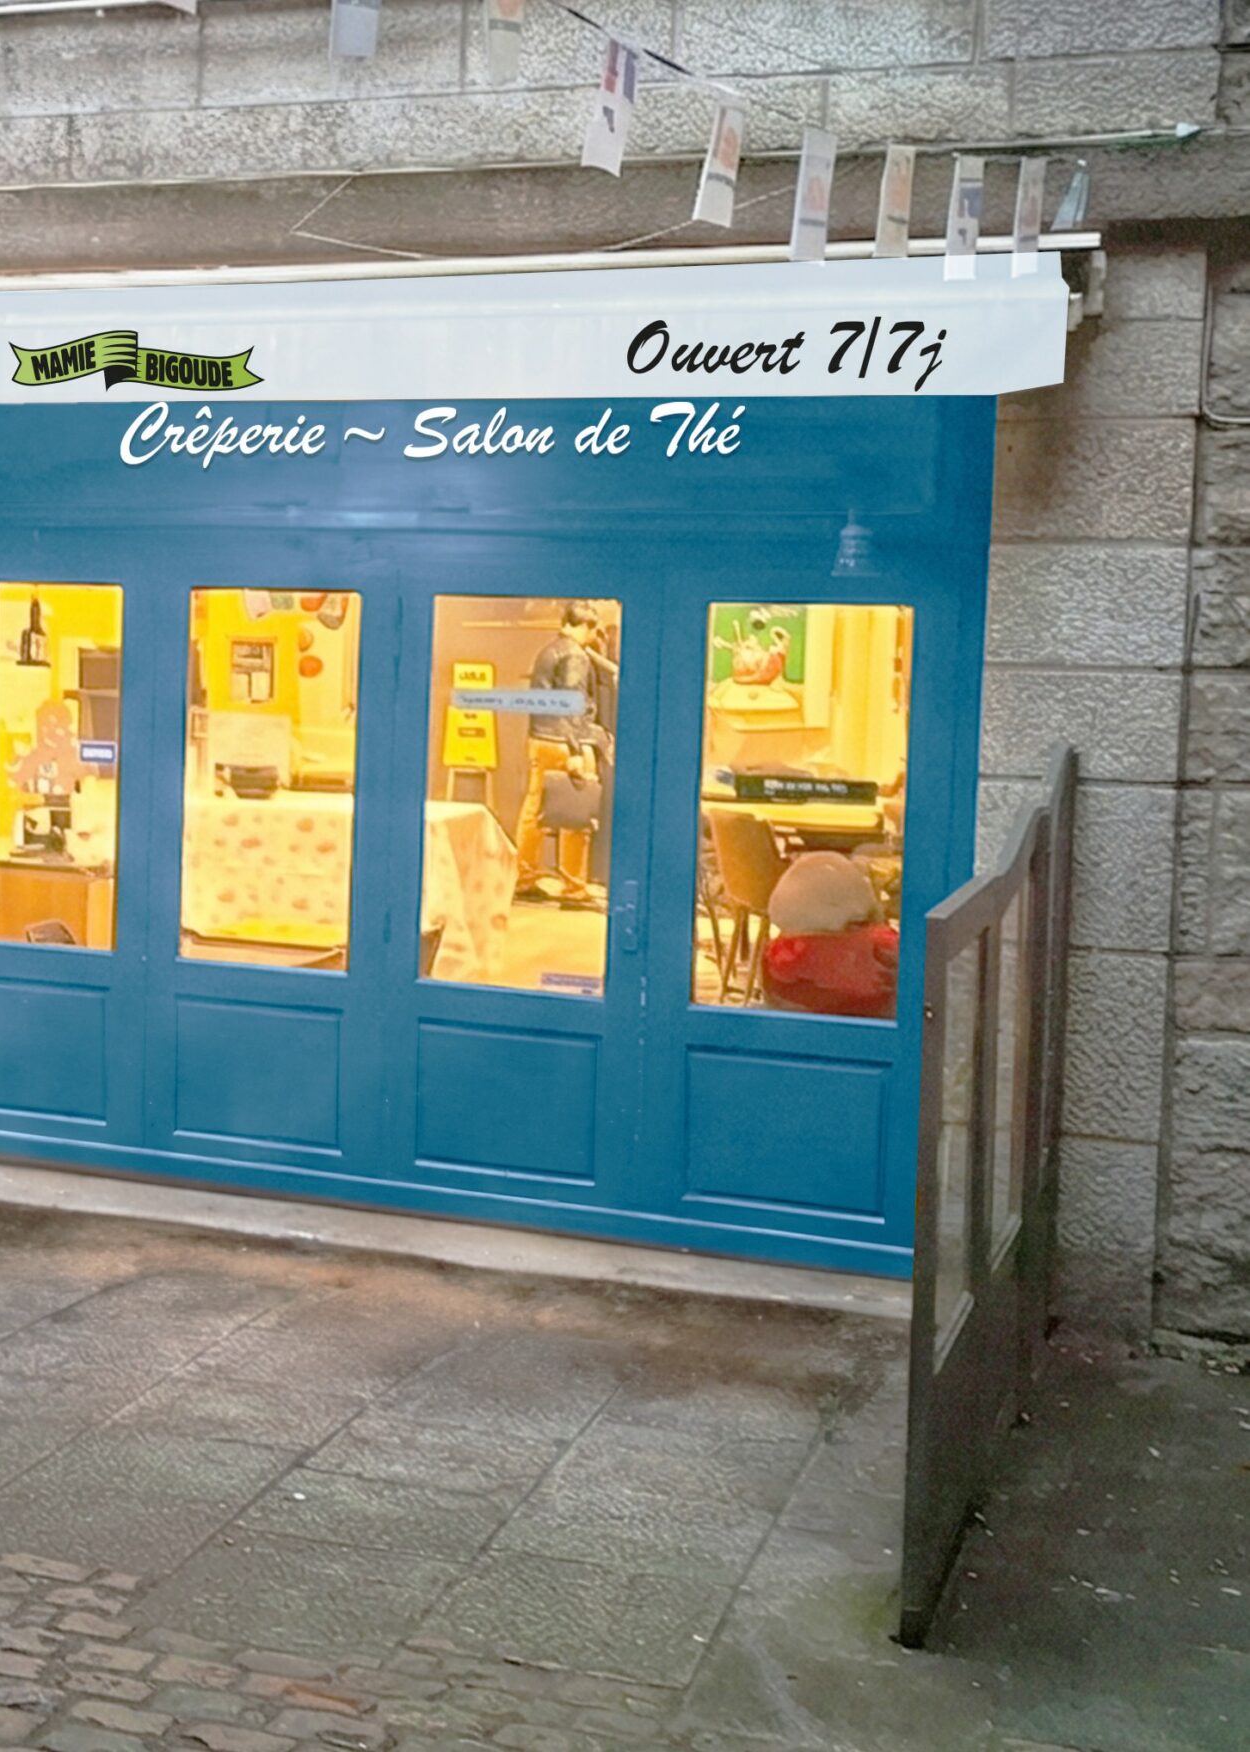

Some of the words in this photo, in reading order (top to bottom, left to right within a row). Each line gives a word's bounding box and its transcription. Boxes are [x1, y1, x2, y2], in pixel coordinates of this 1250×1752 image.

[30, 340, 97, 381] MAMIE
[145, 353, 234, 388] BIGOUDE
[626, 319, 806, 375] Ouvert
[120, 402, 326, 470] Crêperie
[403, 406, 555, 459] Salon
[574, 407, 631, 456] de
[650, 401, 746, 458] Thé
